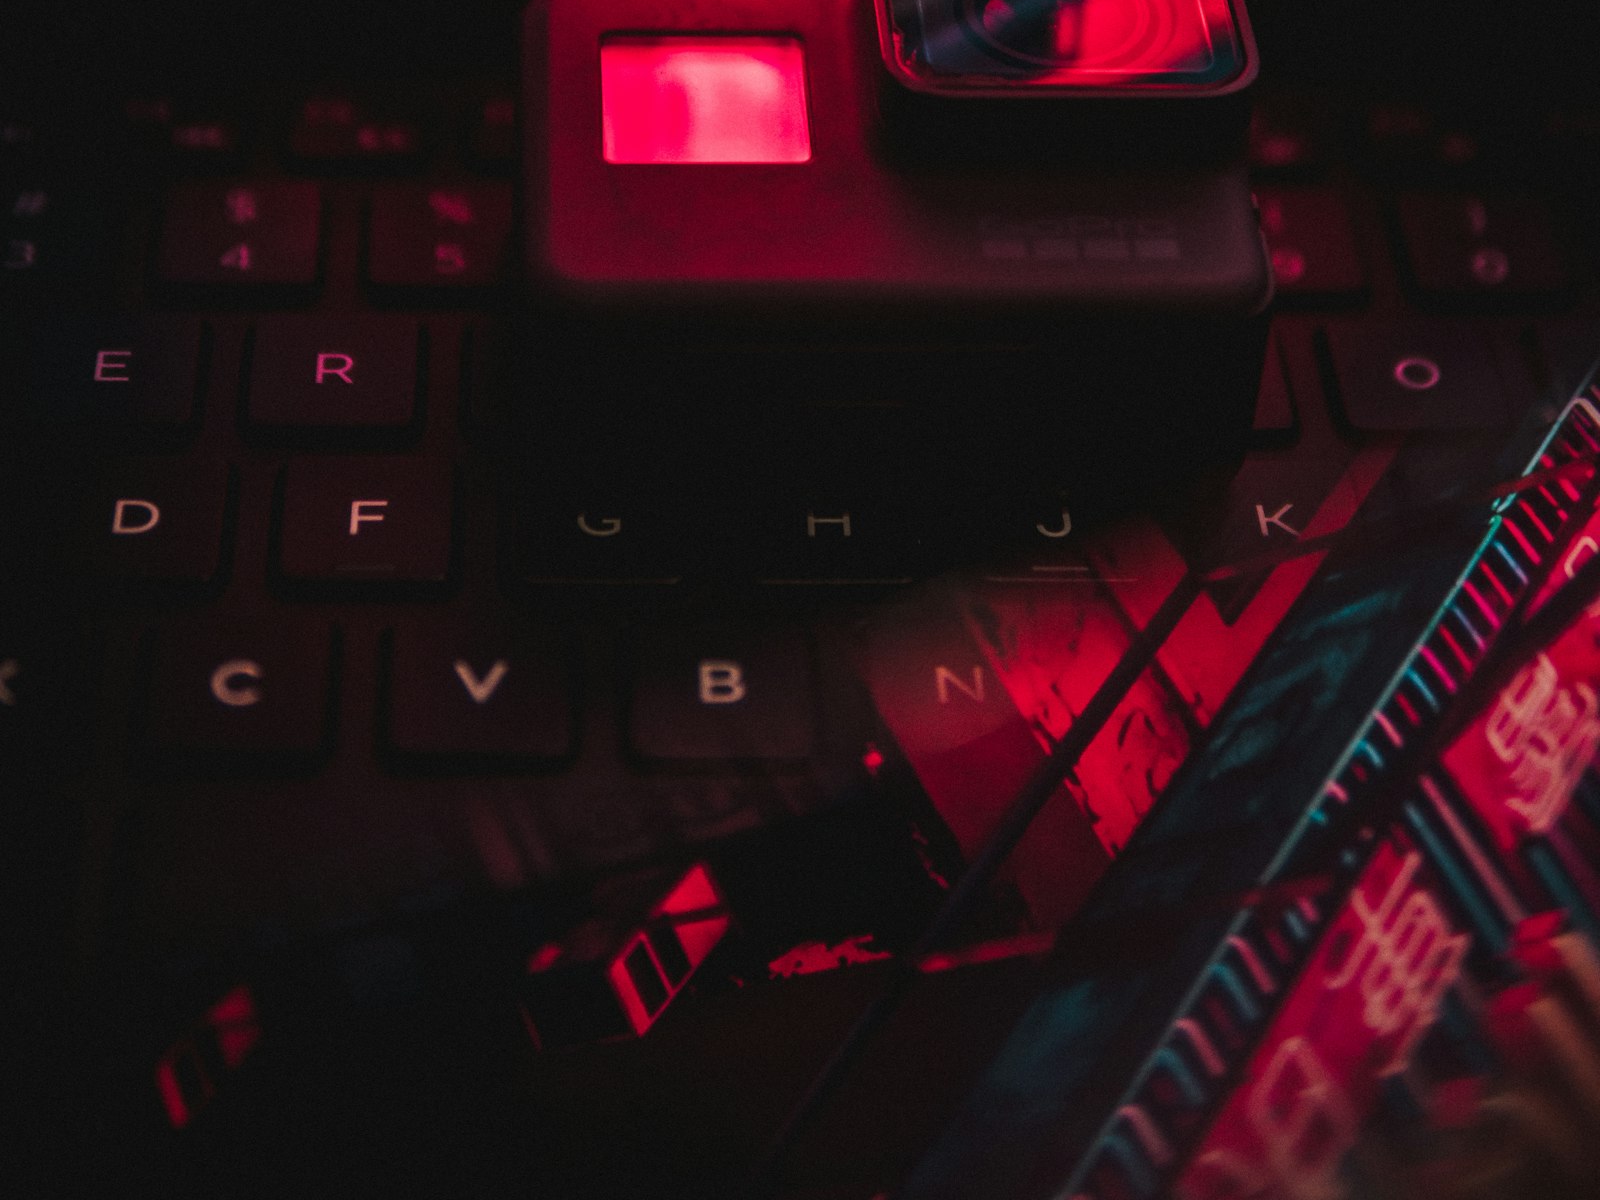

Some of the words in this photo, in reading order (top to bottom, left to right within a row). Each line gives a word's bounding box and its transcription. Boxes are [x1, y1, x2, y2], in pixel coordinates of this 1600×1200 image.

[94, 351, 132, 382] E
[315, 353, 354, 384] R
[111, 499, 161, 535] D
[349, 500, 388, 536] F
[577, 513, 622, 538] G
[807, 513, 852, 538] H
[1036, 507, 1073, 539] J
[1255, 503, 1301, 537] K
[209, 658, 262, 707] C
[453, 658, 509, 704] V
[698, 660, 746, 705] B
[935, 665, 985, 704] N
